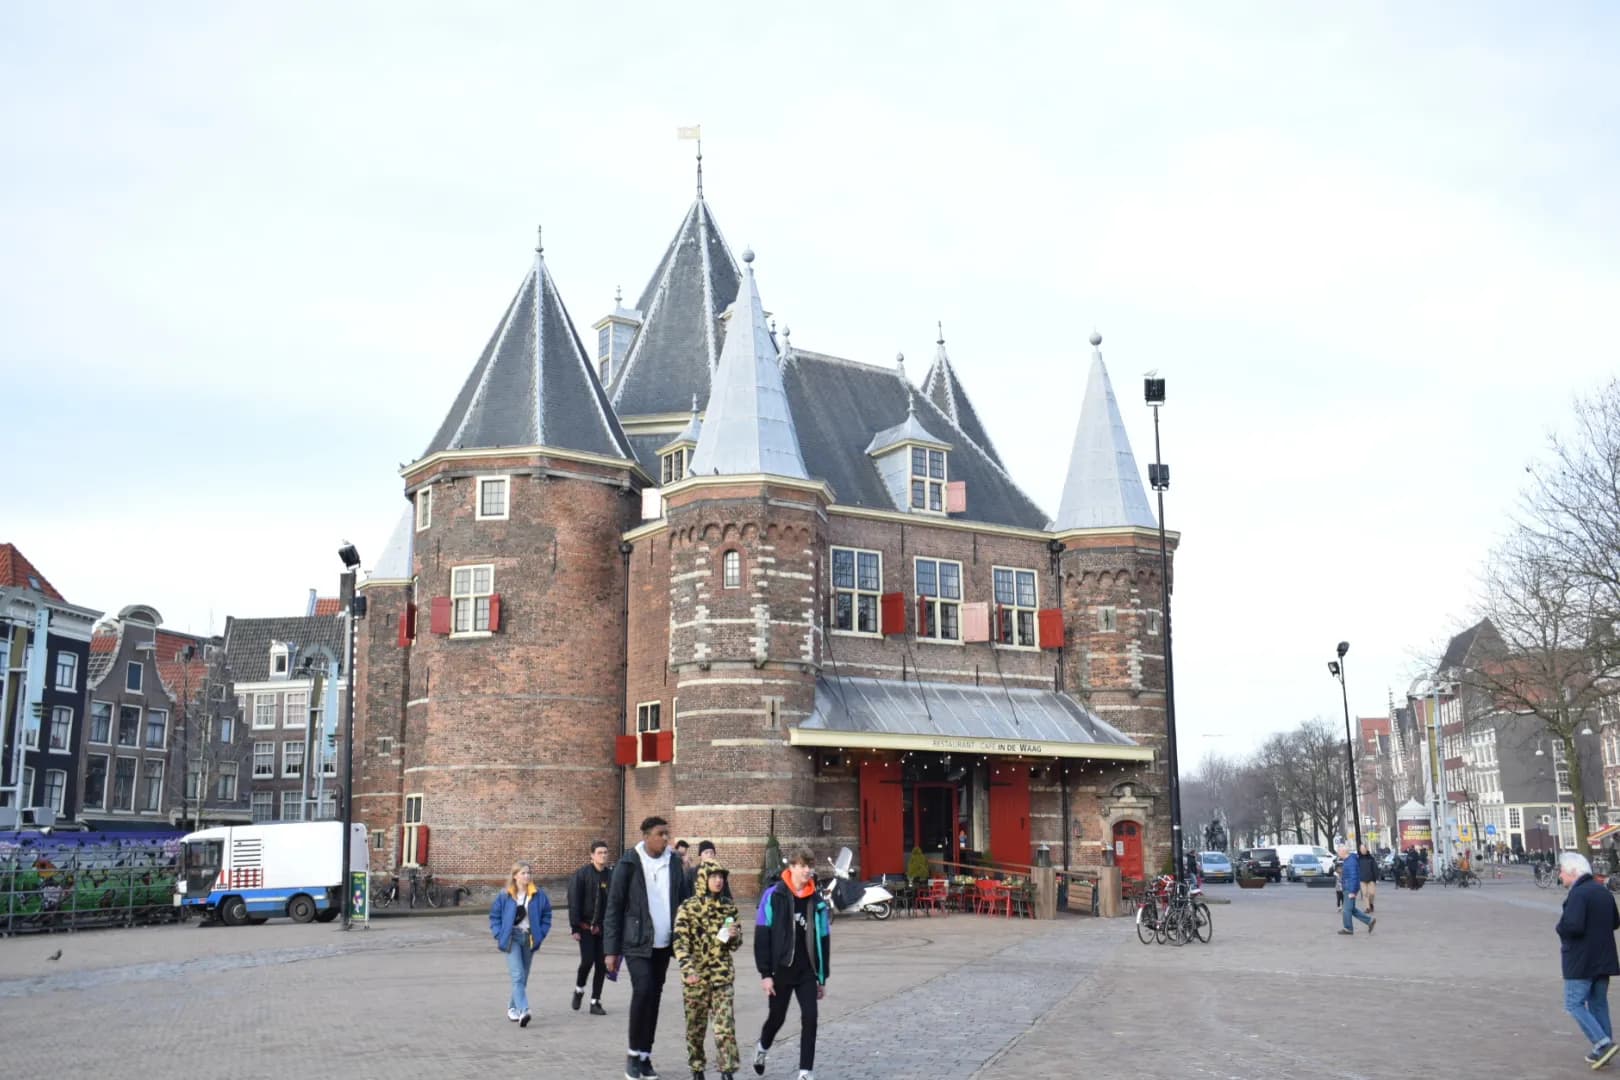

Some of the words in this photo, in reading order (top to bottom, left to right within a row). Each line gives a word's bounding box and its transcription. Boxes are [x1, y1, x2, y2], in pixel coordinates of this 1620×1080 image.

[998, 743, 1005, 751] IN
[1006, 743, 1016, 752] DE
[1019, 743, 1042, 753] WAAG
